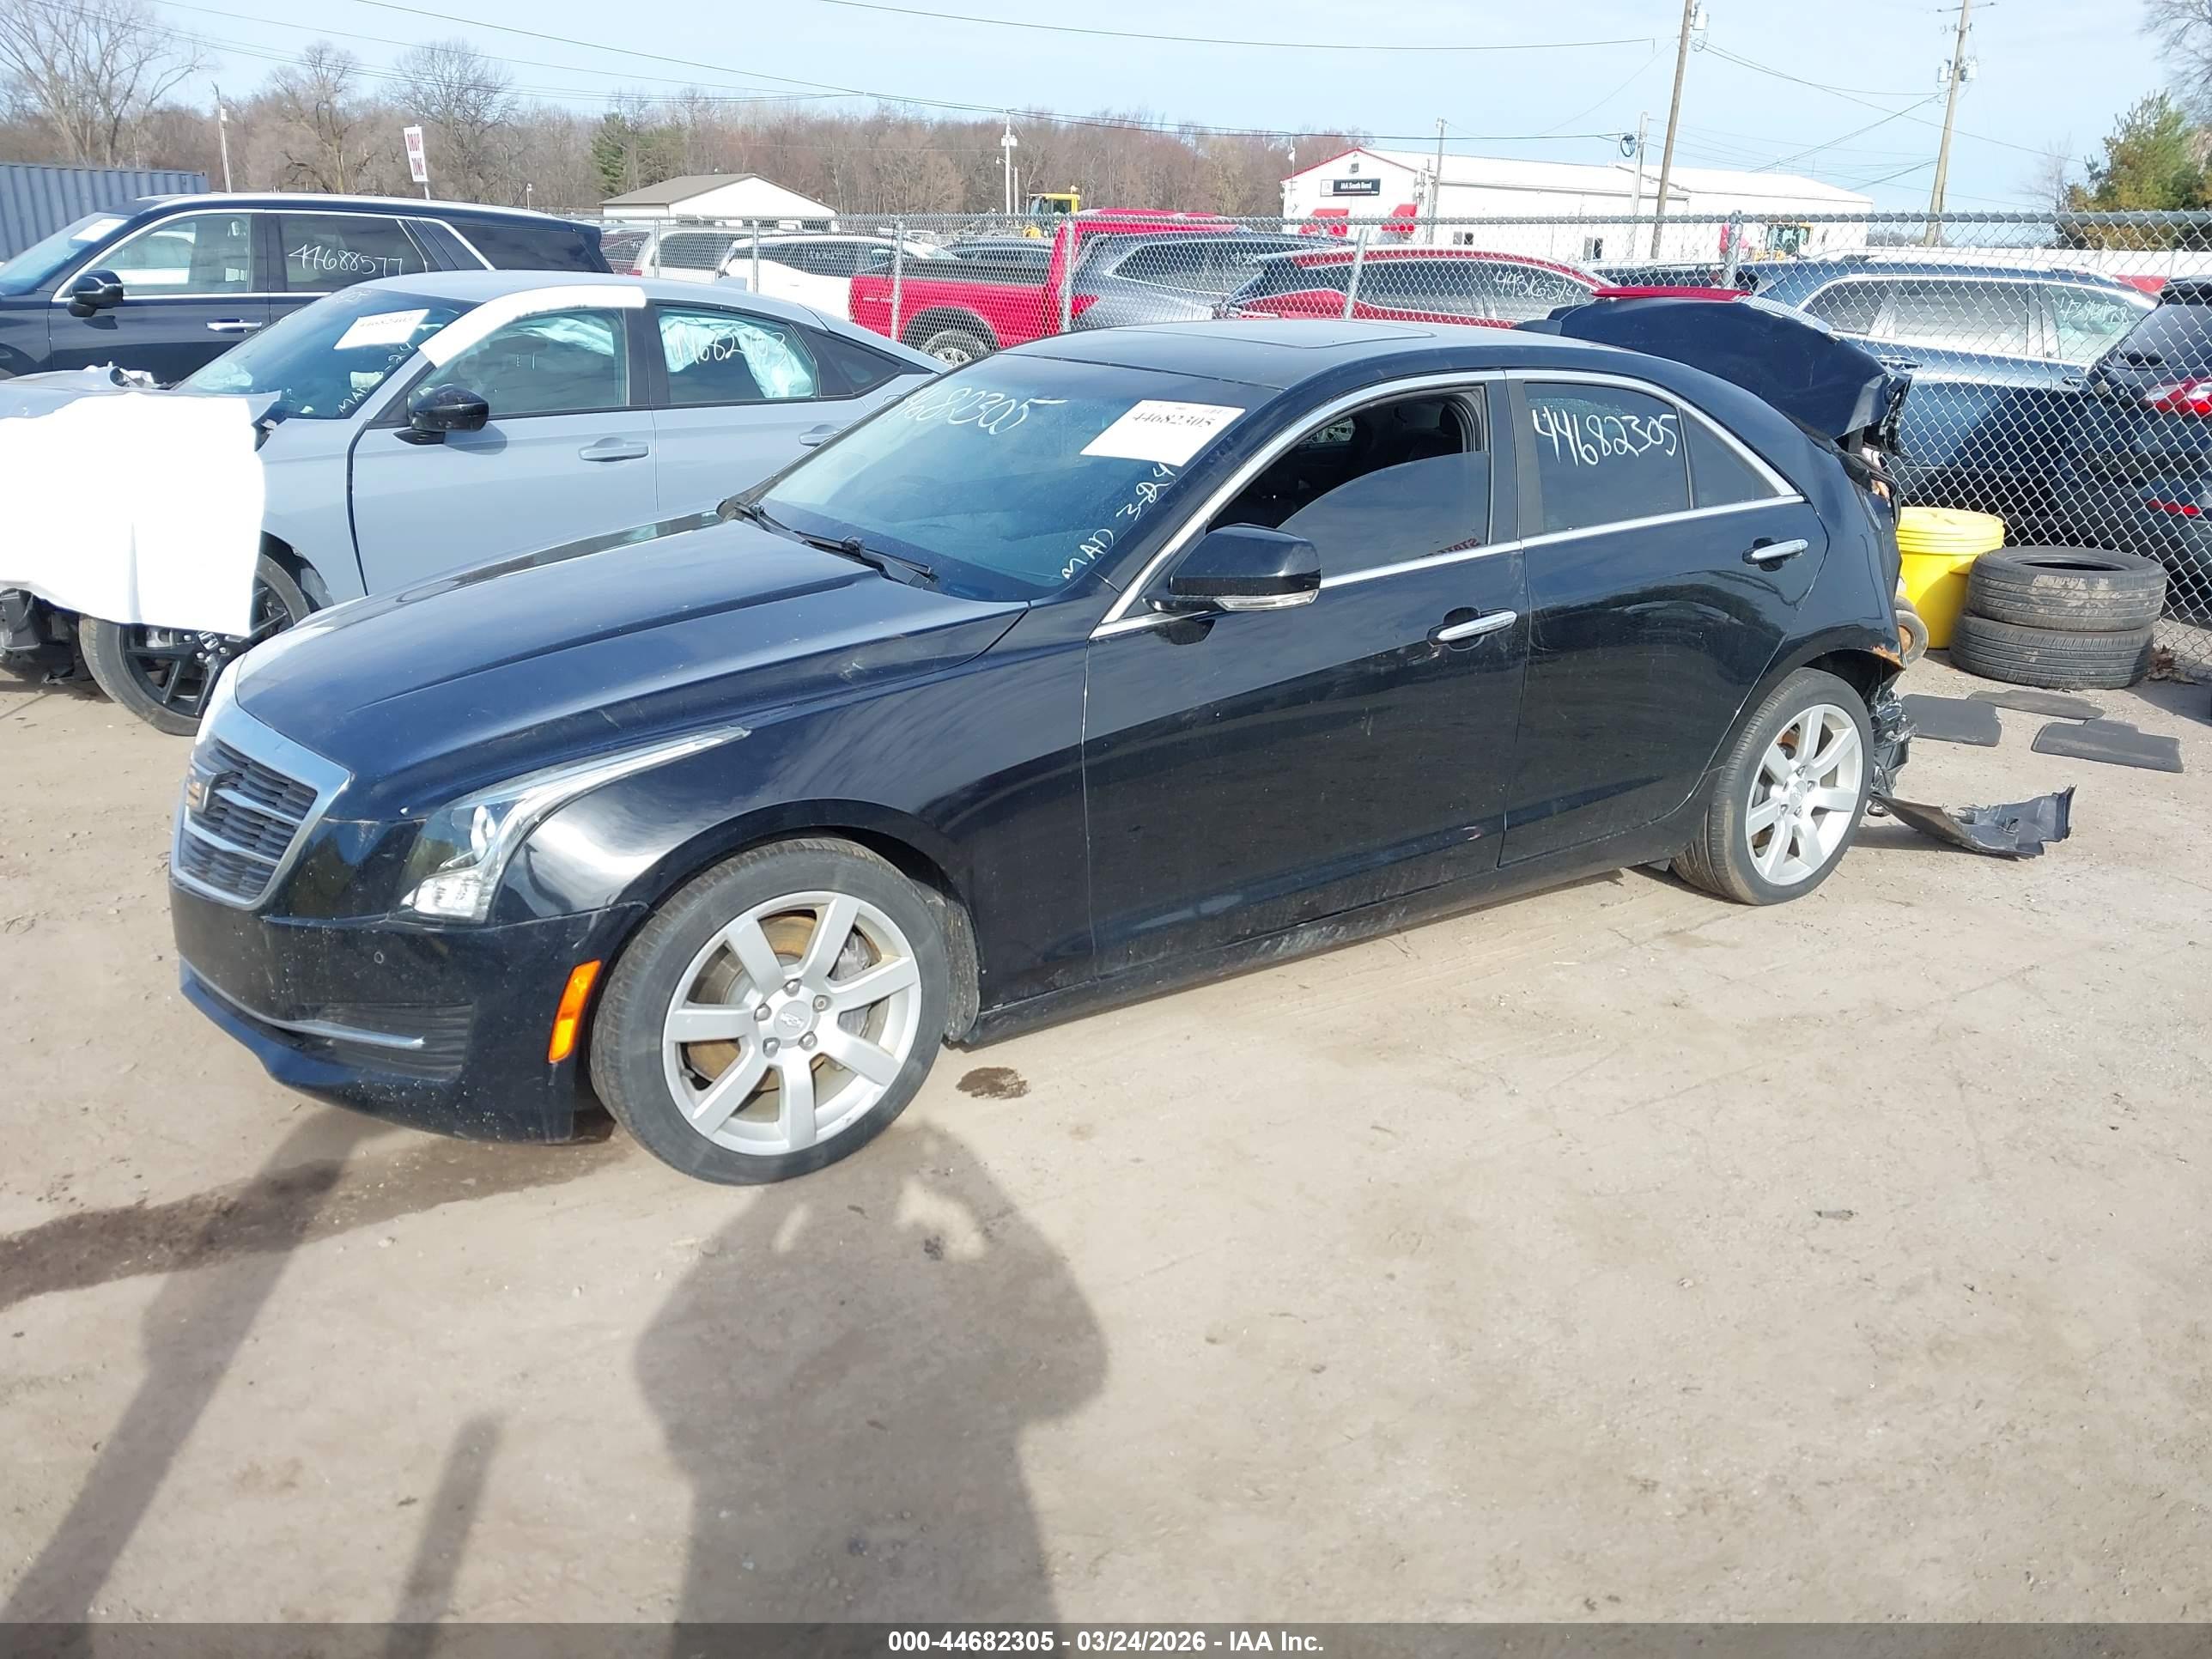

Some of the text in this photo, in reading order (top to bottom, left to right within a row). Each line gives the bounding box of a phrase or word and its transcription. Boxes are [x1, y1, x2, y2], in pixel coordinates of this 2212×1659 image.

[289, 244, 402, 276] 44688577
[1532, 400, 1677, 466] 44682305
[1061, 529, 1113, 579] MAD
